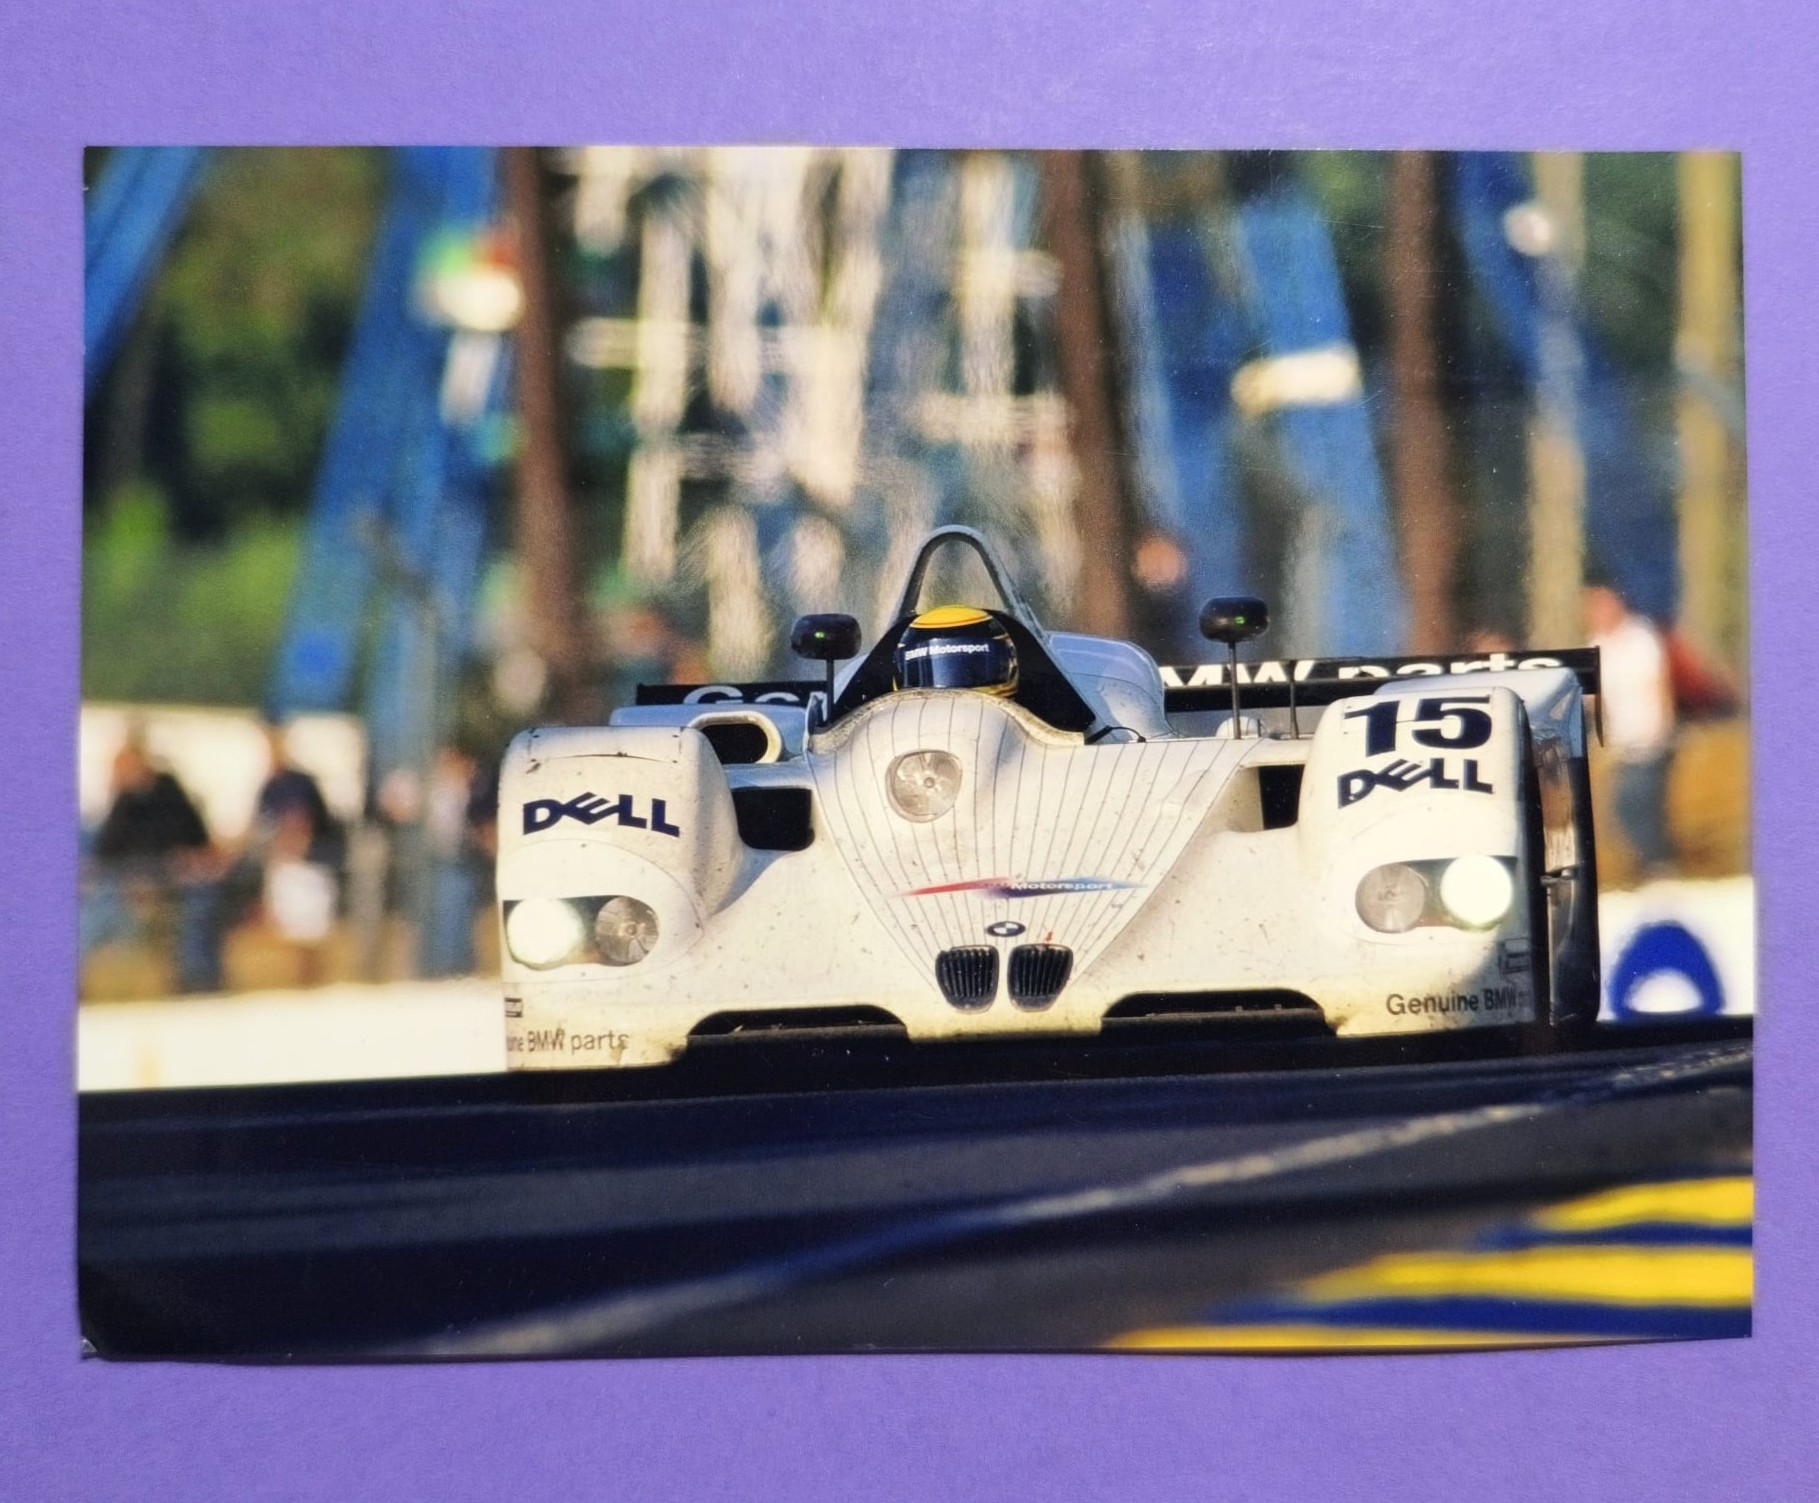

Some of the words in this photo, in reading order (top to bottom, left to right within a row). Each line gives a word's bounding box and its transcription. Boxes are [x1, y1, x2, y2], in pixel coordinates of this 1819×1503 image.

[929, 643, 989, 658] Motorsport
[1158, 660, 1315, 687] MW
[1344, 695, 1492, 757] 15
[1337, 758, 1494, 809] DELL
[523, 792, 680, 838] DELL
[1010, 881, 1113, 892] Motorsport
[1386, 990, 1479, 1015] Genuine
[1483, 986, 1516, 1010] BMW
[527, 1029, 565, 1052] BMW
[570, 1030, 629, 1055] parts
